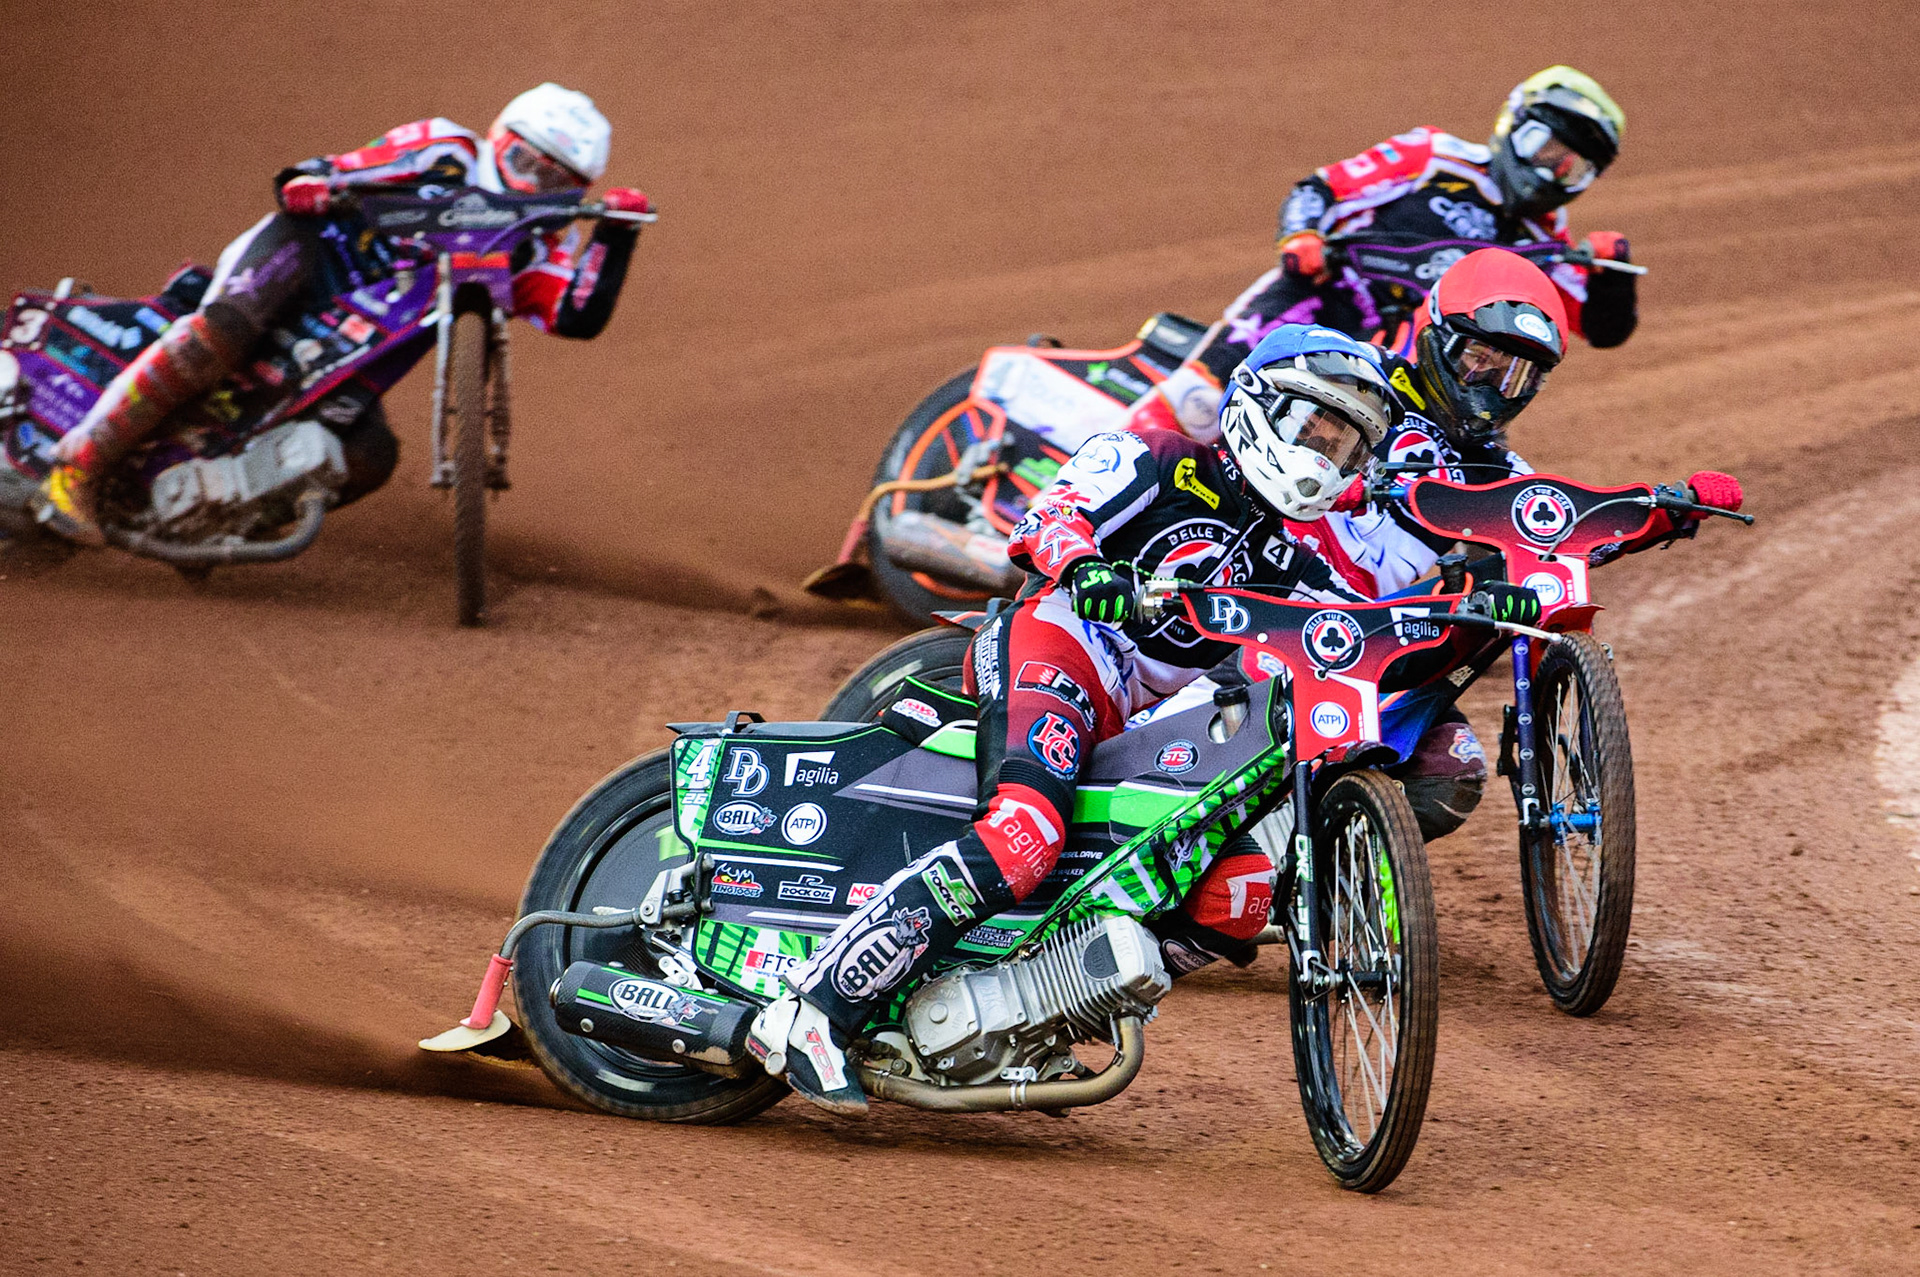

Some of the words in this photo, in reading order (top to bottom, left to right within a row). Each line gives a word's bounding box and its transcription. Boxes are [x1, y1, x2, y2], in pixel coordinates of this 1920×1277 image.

[1222, 457, 1241, 481] FTS
[1168, 527, 1214, 547] BELLE
[1268, 544, 1290, 566] 4
[1306, 615, 1325, 635] BELLE
[1325, 613, 1342, 621] VUE
[1343, 619, 1360, 637] ACES
[1404, 620, 1440, 638] agilia
[1317, 714, 1341, 725] ATPI
[686, 744, 714, 781] 4
[1161, 750, 1190, 761] STS
[796, 767, 839, 787] agilia
[682, 792, 709, 805] 26
[790, 818, 816, 830] ATPI
[1003, 820, 1048, 878] agilia
[781, 887, 811, 896] ROCK
[813, 890, 831, 898] OIL
[850, 885, 876, 898] NG
[929, 869, 955, 904] ROCK
